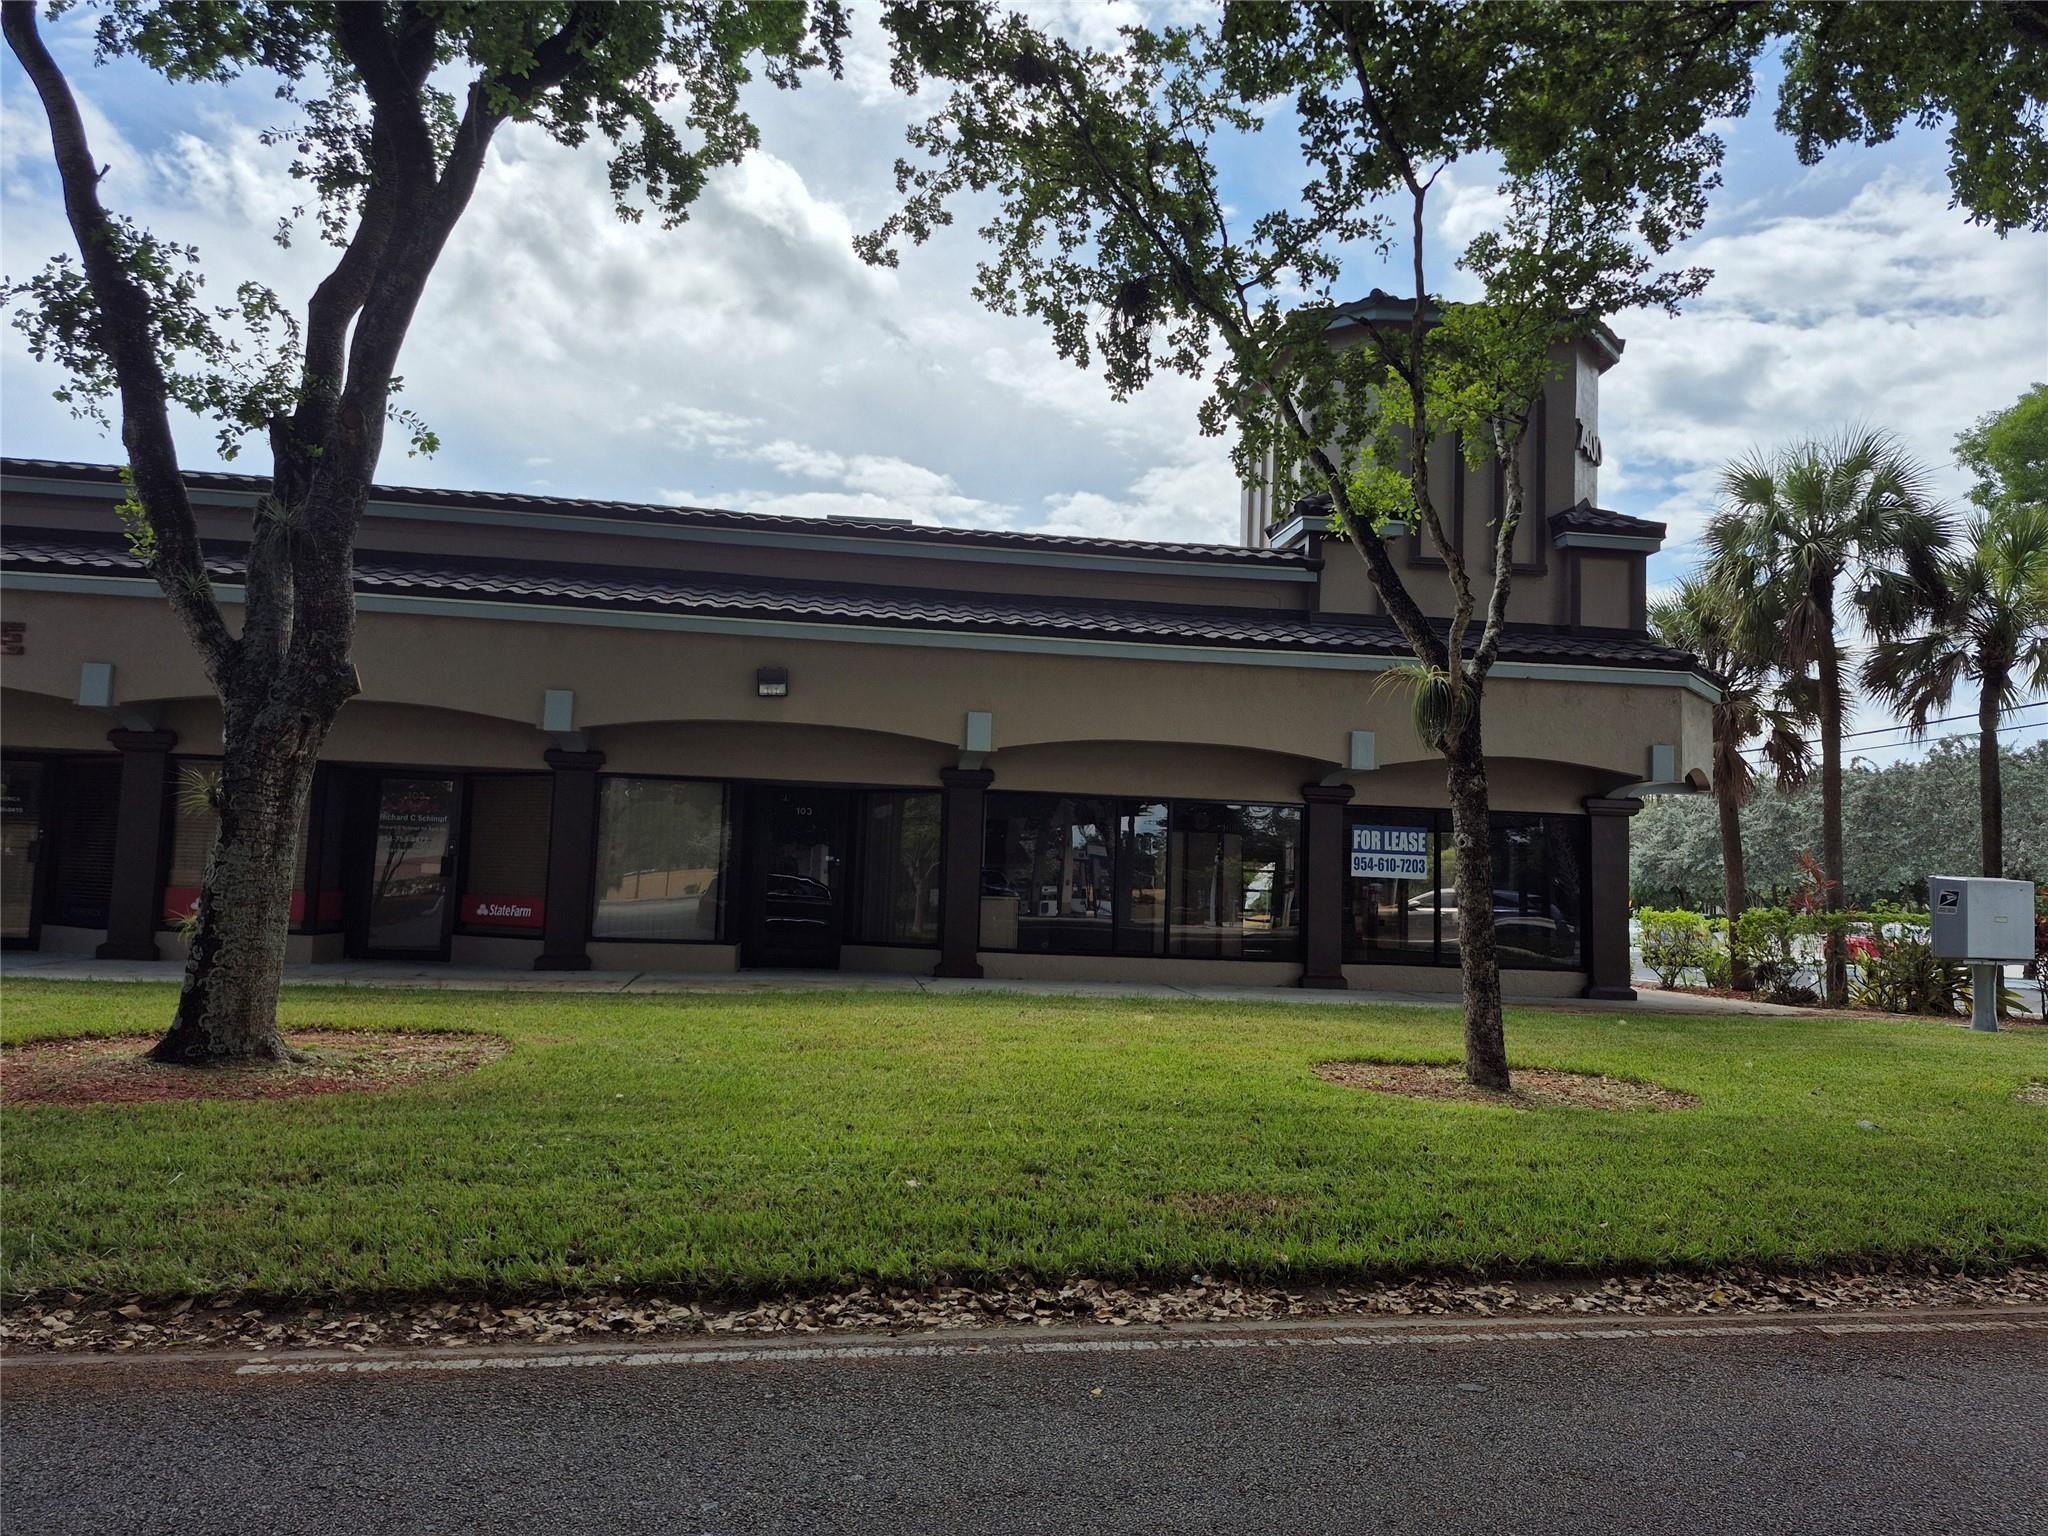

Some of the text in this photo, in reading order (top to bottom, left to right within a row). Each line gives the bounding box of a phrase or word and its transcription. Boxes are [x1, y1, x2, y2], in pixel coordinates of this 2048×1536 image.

[379, 812, 408, 821] Richard
[418, 814, 447, 823] Schimpf
[796, 807, 813, 816] 103
[1353, 829, 1426, 852] FOR LEASE
[1353, 856, 1426, 874] 954-610-7203
